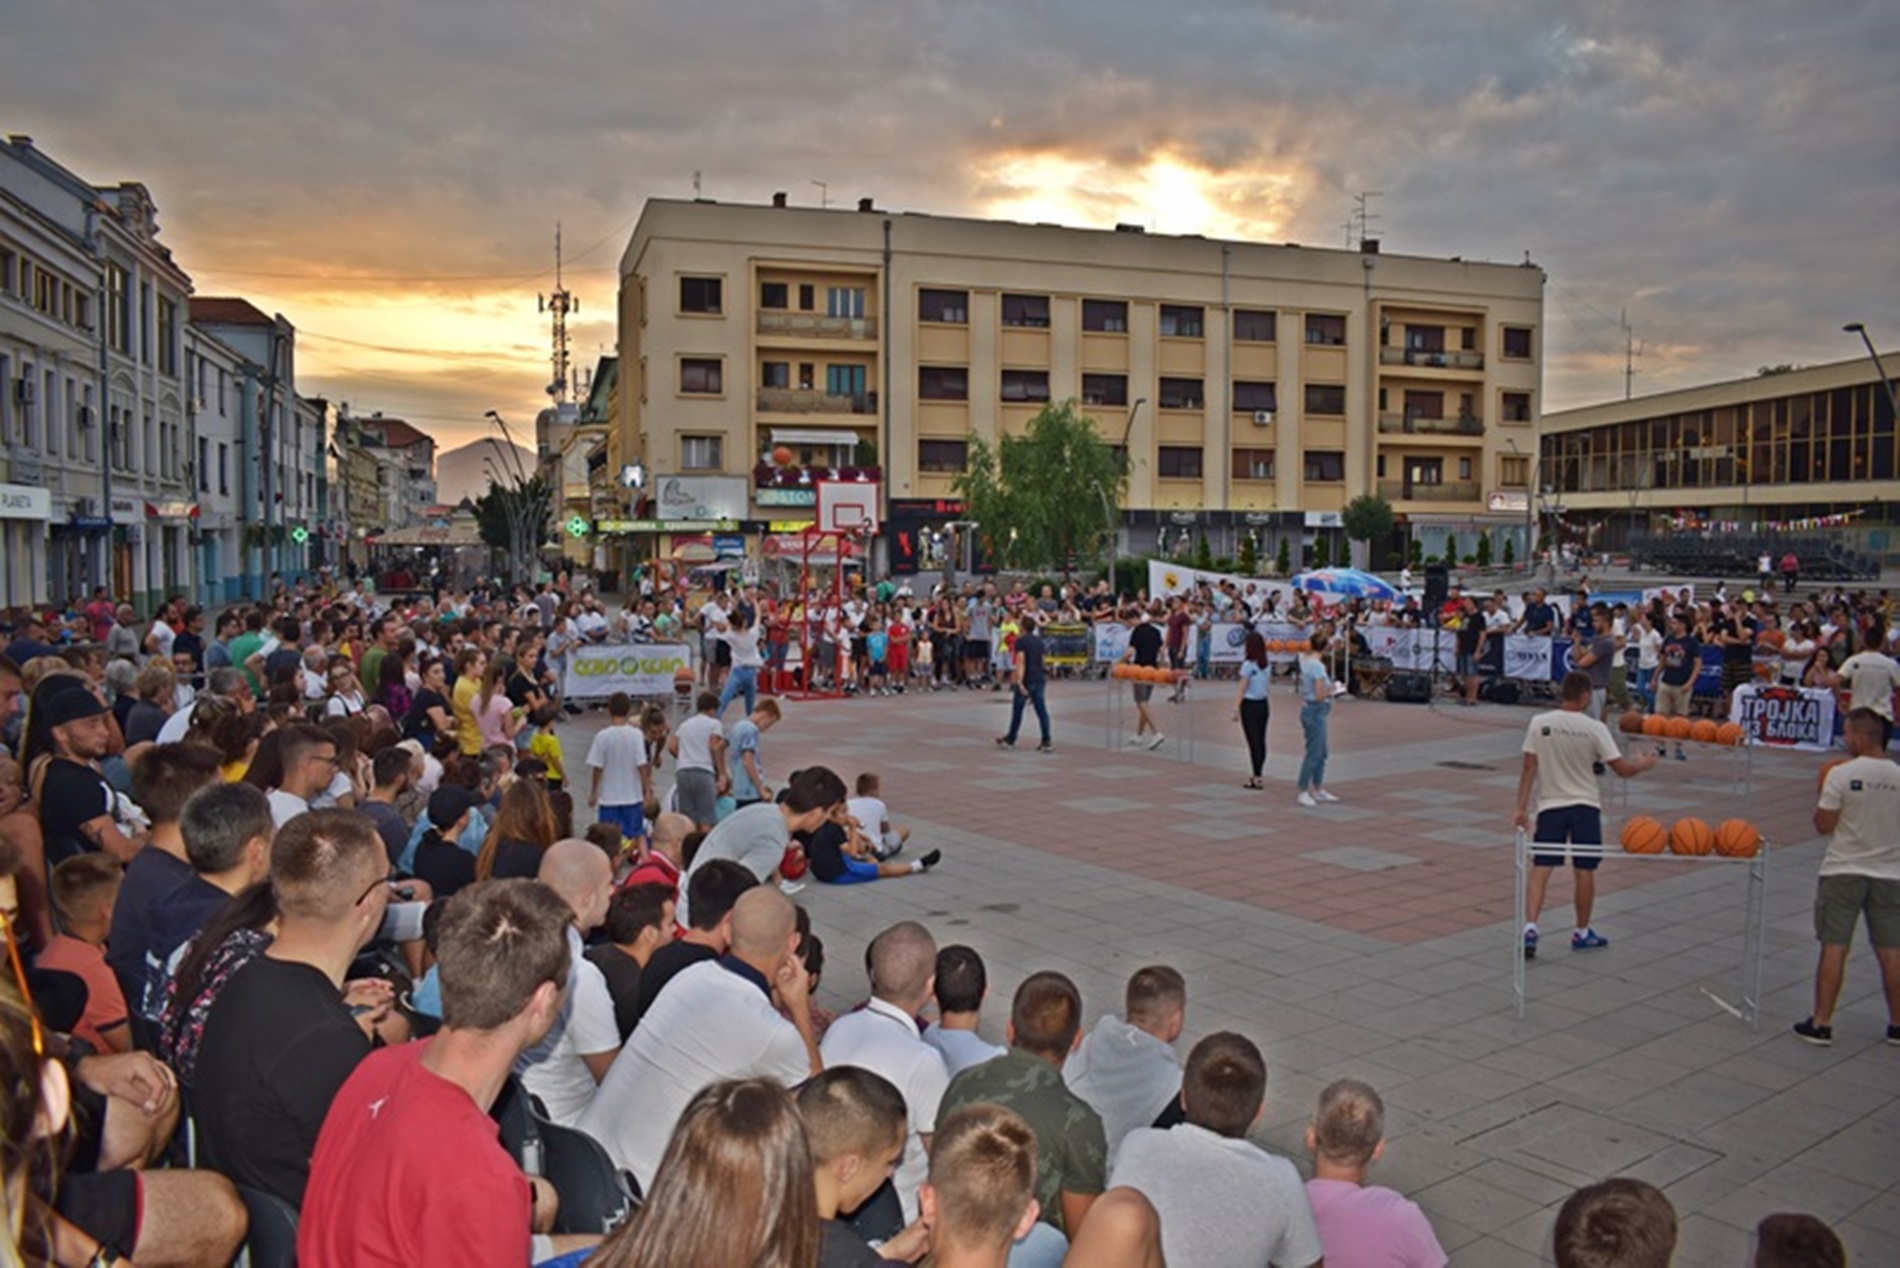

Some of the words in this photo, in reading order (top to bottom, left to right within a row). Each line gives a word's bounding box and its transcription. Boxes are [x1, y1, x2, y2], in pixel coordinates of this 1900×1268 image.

[1743, 698, 1818, 723] ТРОЈКА
[1742, 720, 1760, 736] ИЗ
[1766, 721, 1818, 740] БЛОКА
